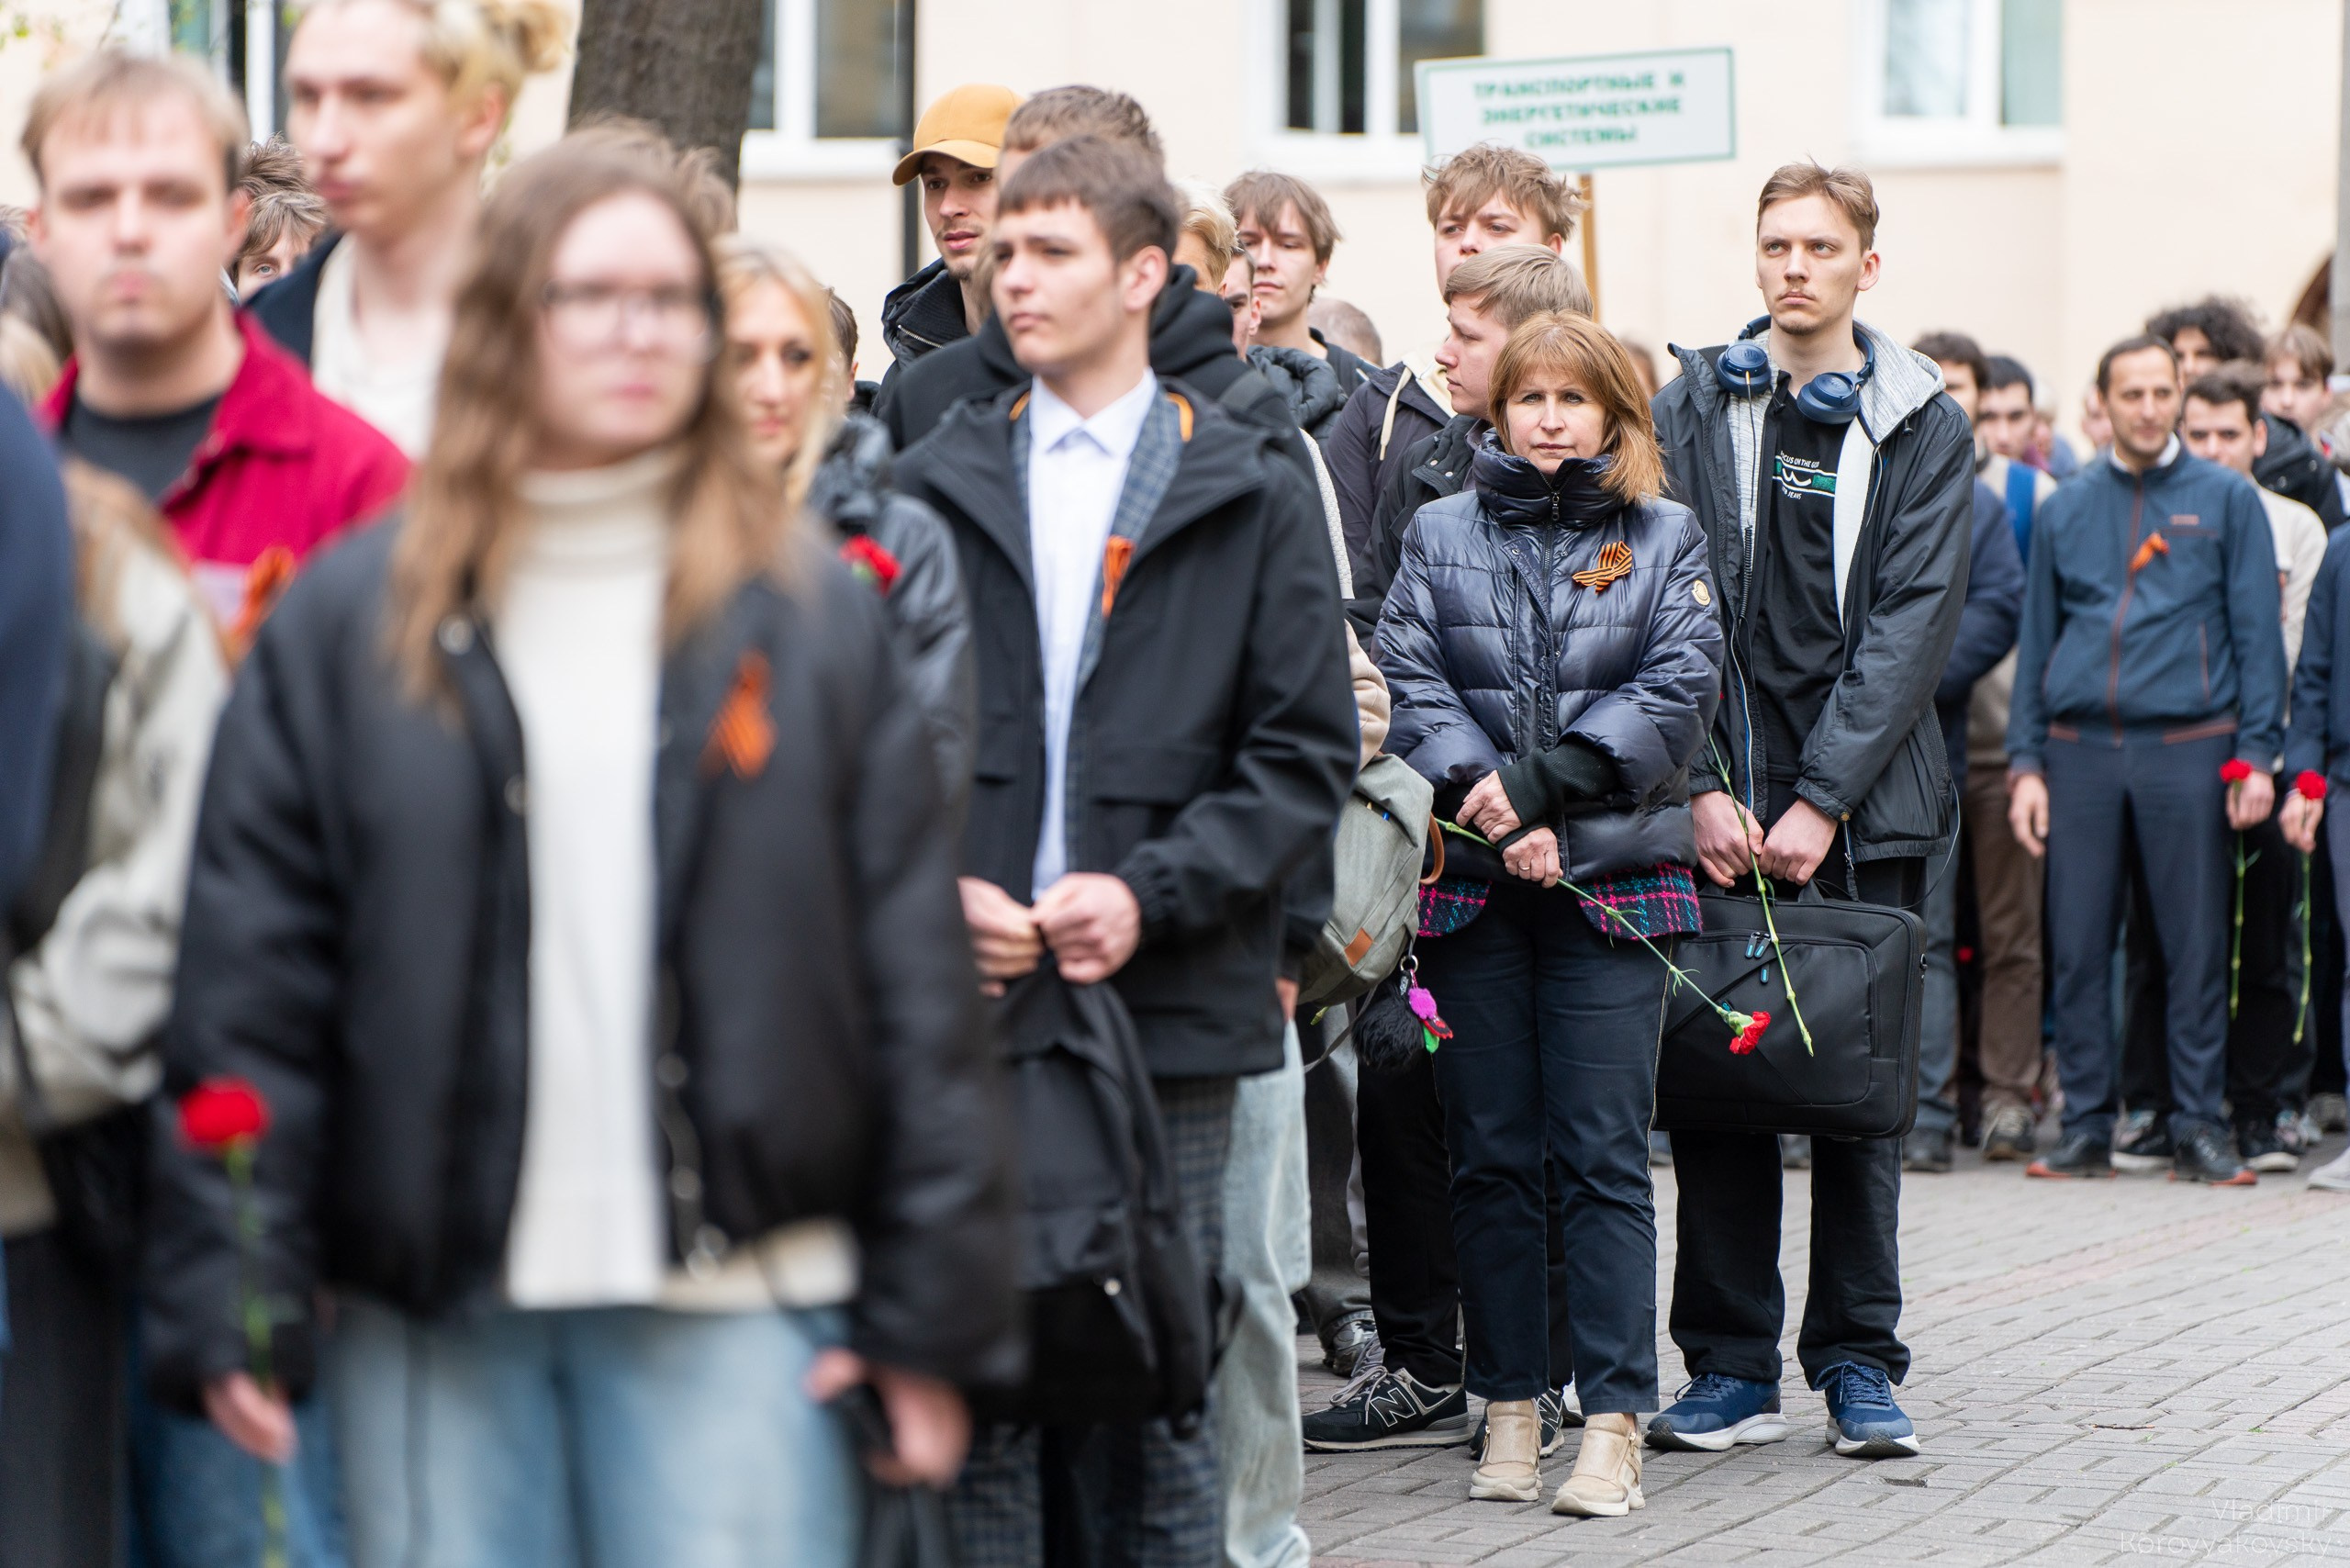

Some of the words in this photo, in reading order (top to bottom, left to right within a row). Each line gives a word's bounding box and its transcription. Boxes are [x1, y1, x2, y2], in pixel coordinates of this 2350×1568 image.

[1475, 73, 1654, 96] ТРАНСПОРТНЫЕ
[1670, 73, 1684, 86] И
[1483, 98, 1680, 123] ЭНЕРГЕТИЧЕСКИЕ
[1527, 128, 1636, 147] СИСТЕМЫ
[1801, 459, 1811, 467] THE
